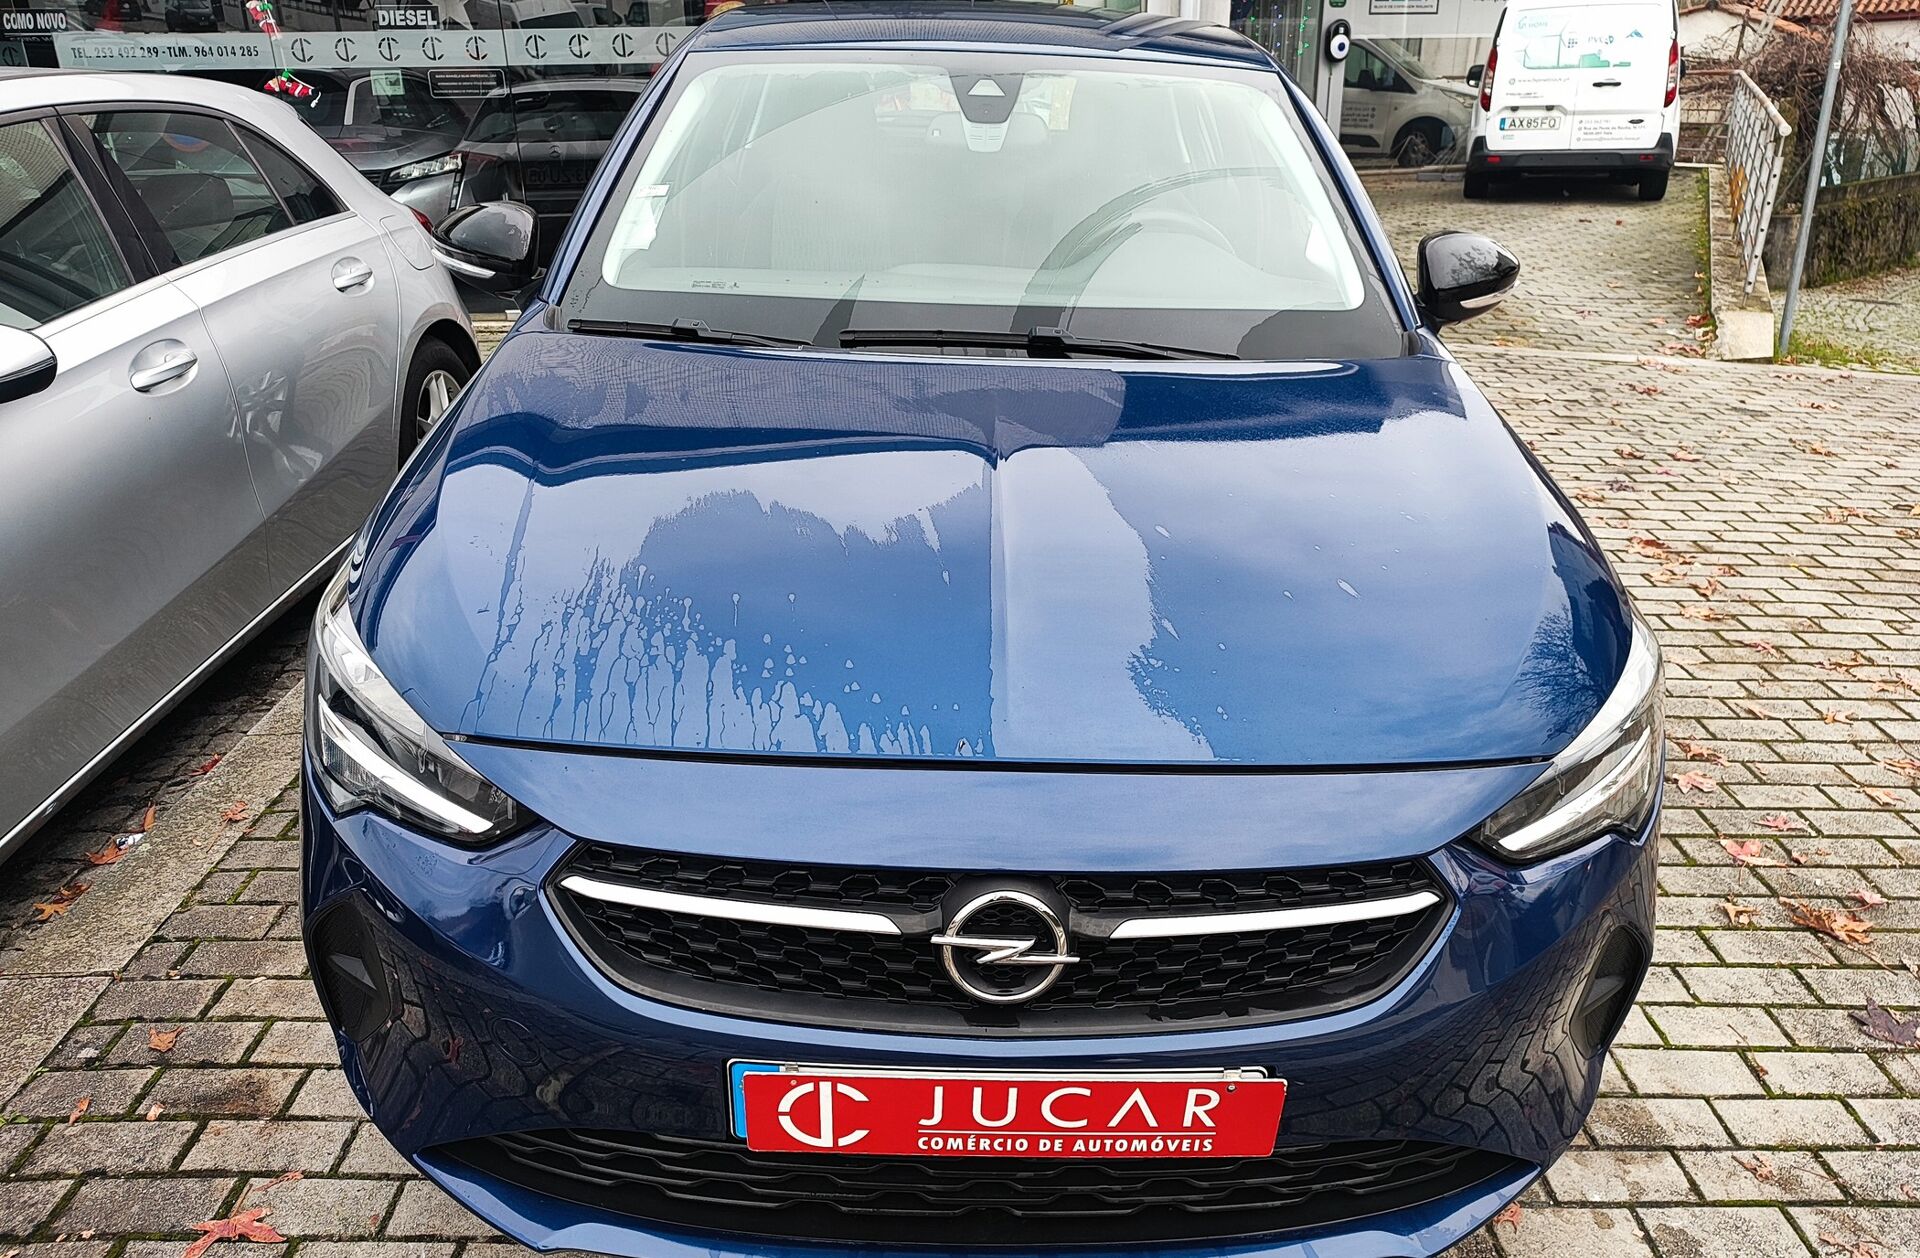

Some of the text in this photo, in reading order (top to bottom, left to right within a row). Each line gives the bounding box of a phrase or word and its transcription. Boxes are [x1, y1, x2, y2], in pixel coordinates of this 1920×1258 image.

[3, 12, 67, 30] COMO NOVO
[377, 9, 438, 26] DIESEL
[70, 46, 93, 59] TEL.
[194, 45, 214, 57] 964
[216, 45, 238, 57] 014
[239, 45, 260, 57] 285
[1508, 117, 1557, 129] AX85FQ
[917, 1086, 1221, 1128] JUCAR
[917, 1135, 1213, 1152] COMÉRCIO DE AUTOMÓVEIS
